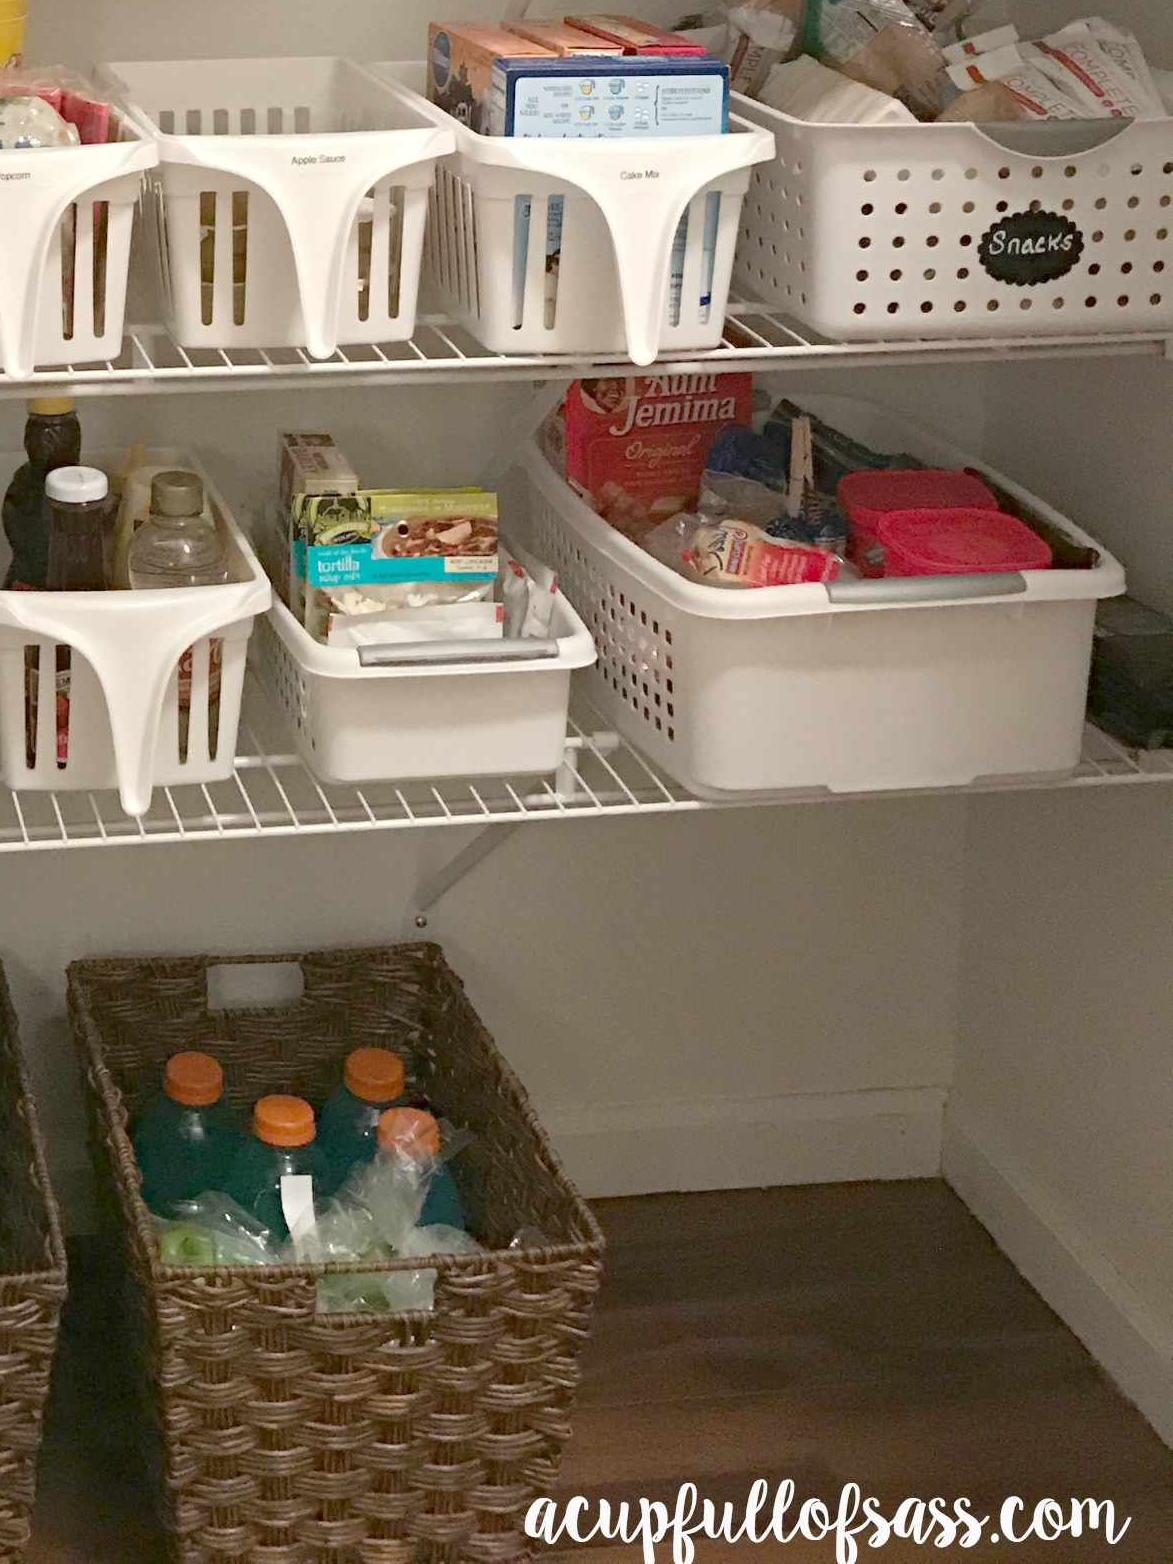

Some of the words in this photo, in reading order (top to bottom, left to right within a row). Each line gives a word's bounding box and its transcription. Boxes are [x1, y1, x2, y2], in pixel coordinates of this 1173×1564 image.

[1062, 41, 1141, 117] COMPLETE
[291, 153, 316, 167] Apple
[319, 152, 346, 165] Sauce
[620, 169, 643, 181] Cake
[644, 168, 661, 180] Mix
[989, 231, 1074, 257] Snacks
[608, 395, 737, 437] Jemima
[624, 433, 702, 469] Original
[317, 557, 360, 574] tortilla
[319, 573, 341, 585] soup
